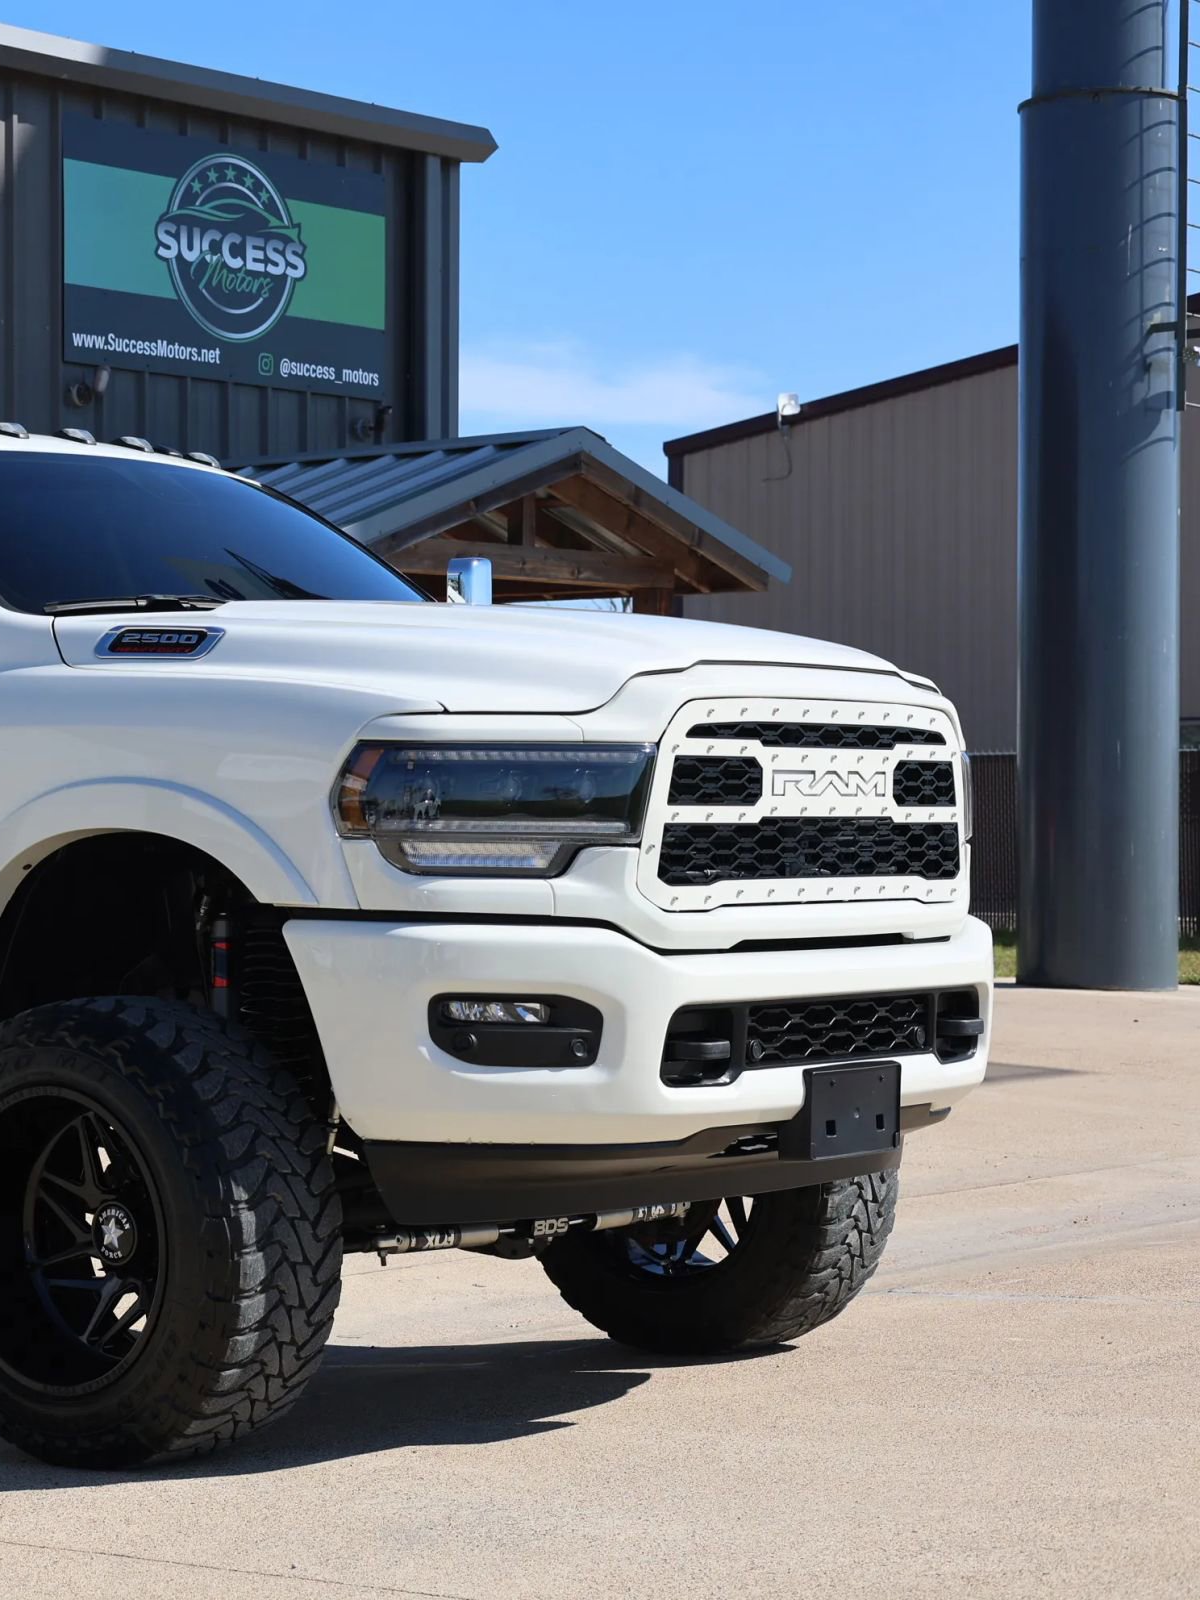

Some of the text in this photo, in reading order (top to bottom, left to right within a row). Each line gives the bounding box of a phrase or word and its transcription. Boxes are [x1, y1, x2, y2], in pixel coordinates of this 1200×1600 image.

[156, 221, 305, 279] SUCCESS
[191, 250, 274, 299] Motors
[72, 332, 221, 364] www.SuccessMotors.net
[280, 358, 379, 386] @success_motors
[120, 633, 199, 644] 2500
[771, 769, 886, 797] RAM
[98, 1208, 131, 1230] AMERICAN
[533, 1217, 569, 1237] BDS
[100, 1245, 123, 1259] FORCE
